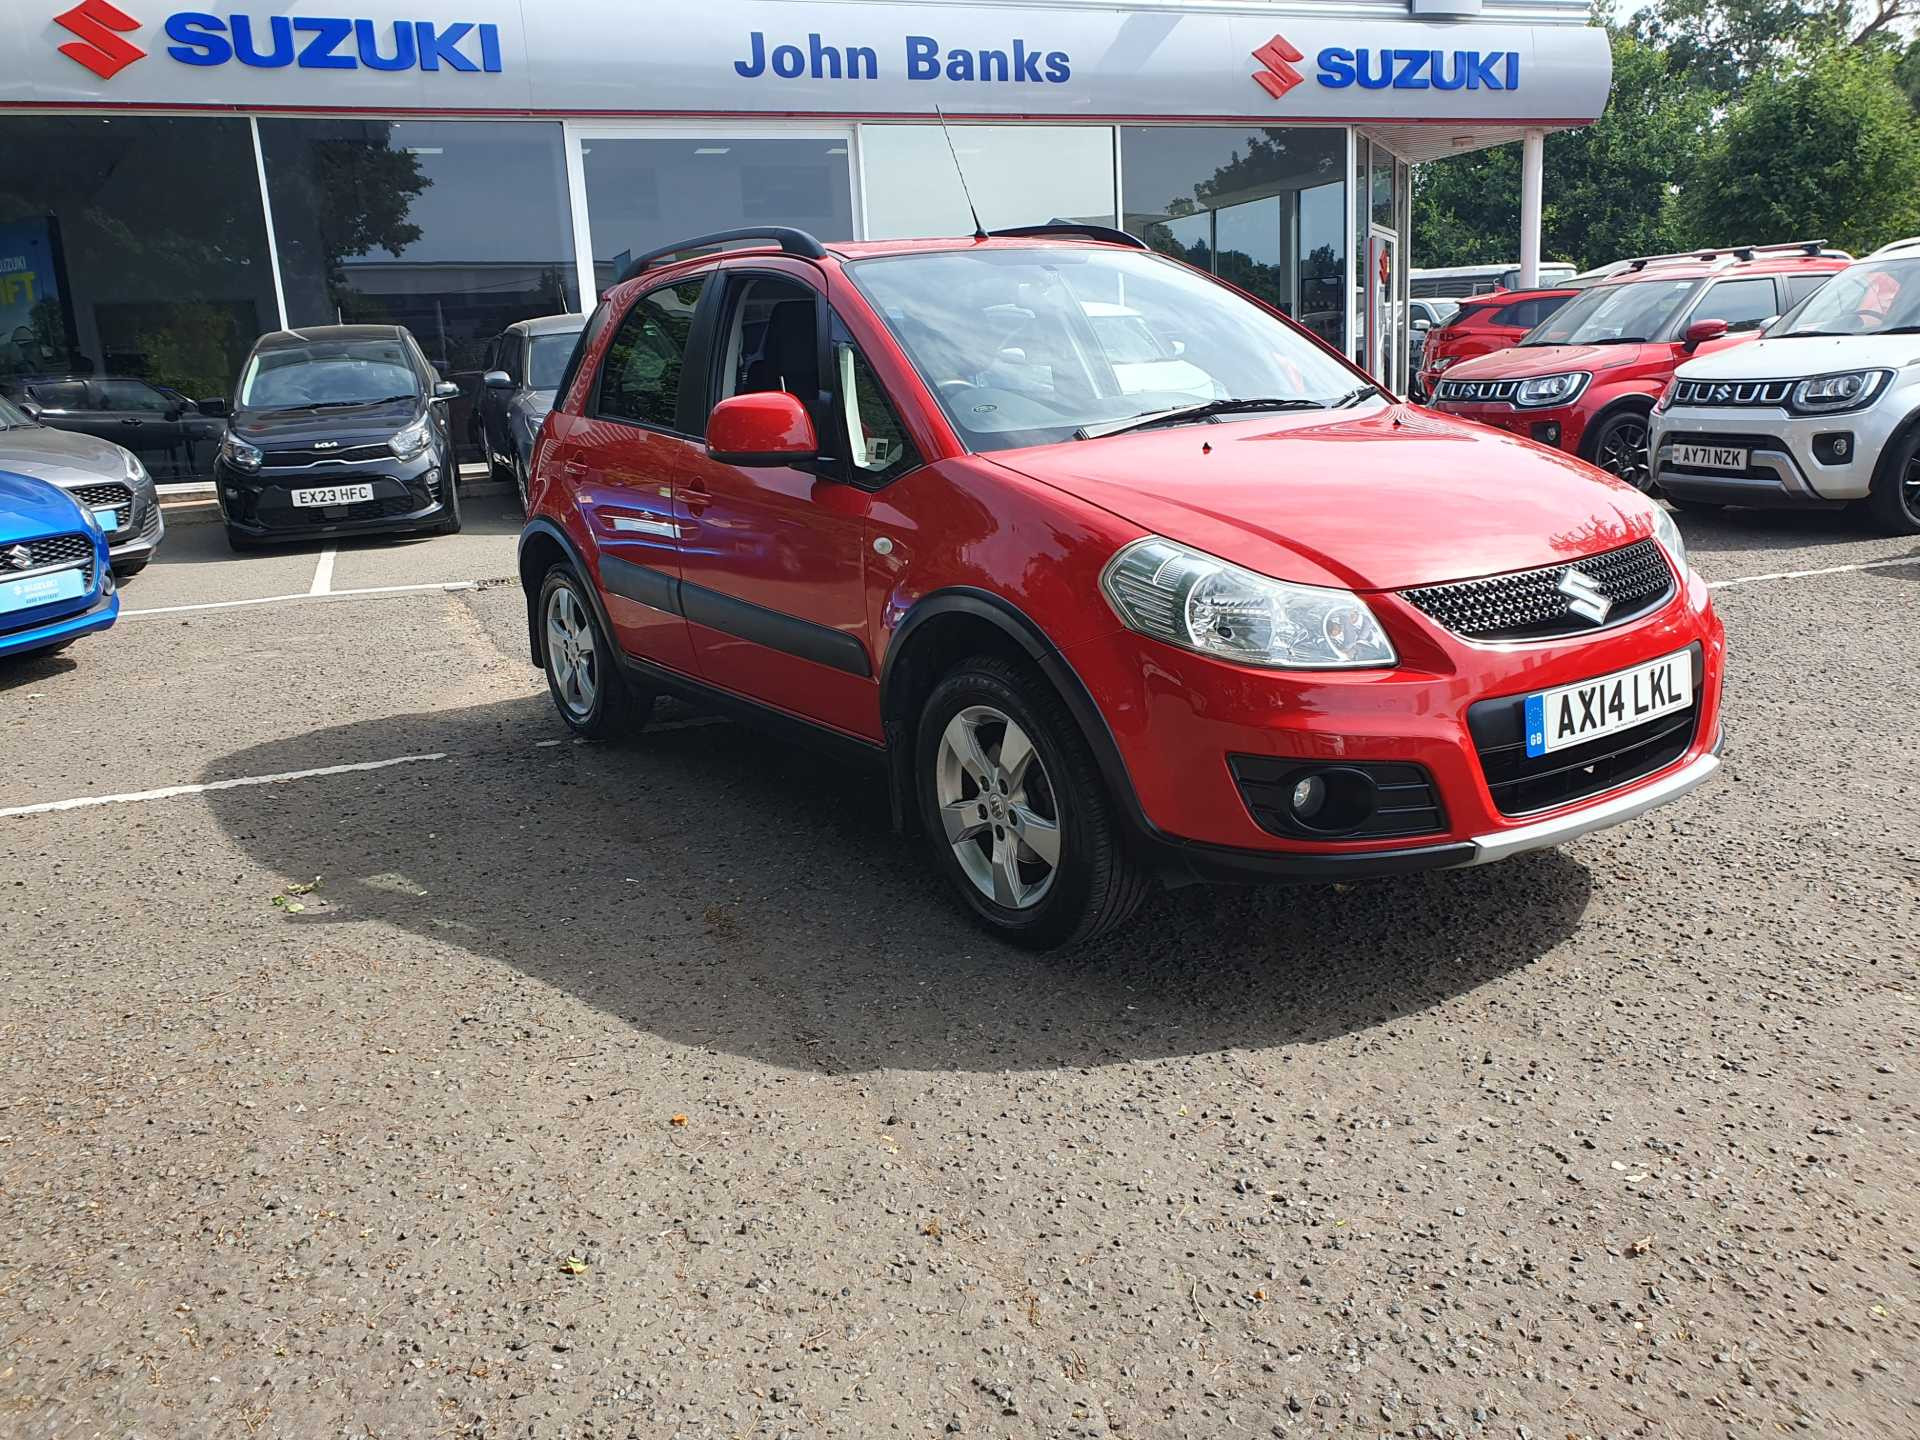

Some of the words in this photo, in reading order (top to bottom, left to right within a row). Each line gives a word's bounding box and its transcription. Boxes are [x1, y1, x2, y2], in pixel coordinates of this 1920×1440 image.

[165, 12, 502, 72] SUZUKI
[734, 31, 878, 79] John
[906, 35, 1071, 83] Banks
[1317, 47, 1519, 91] SUZUKI
[1683, 447, 1711, 464] AY71
[1714, 449, 1740, 466] NZK
[299, 490, 336, 504] EX23
[340, 486, 368, 501] HFC
[1558, 679, 1625, 739] AX14
[1634, 663, 1682, 715] LKL
[1530, 732, 1542, 746] GB
